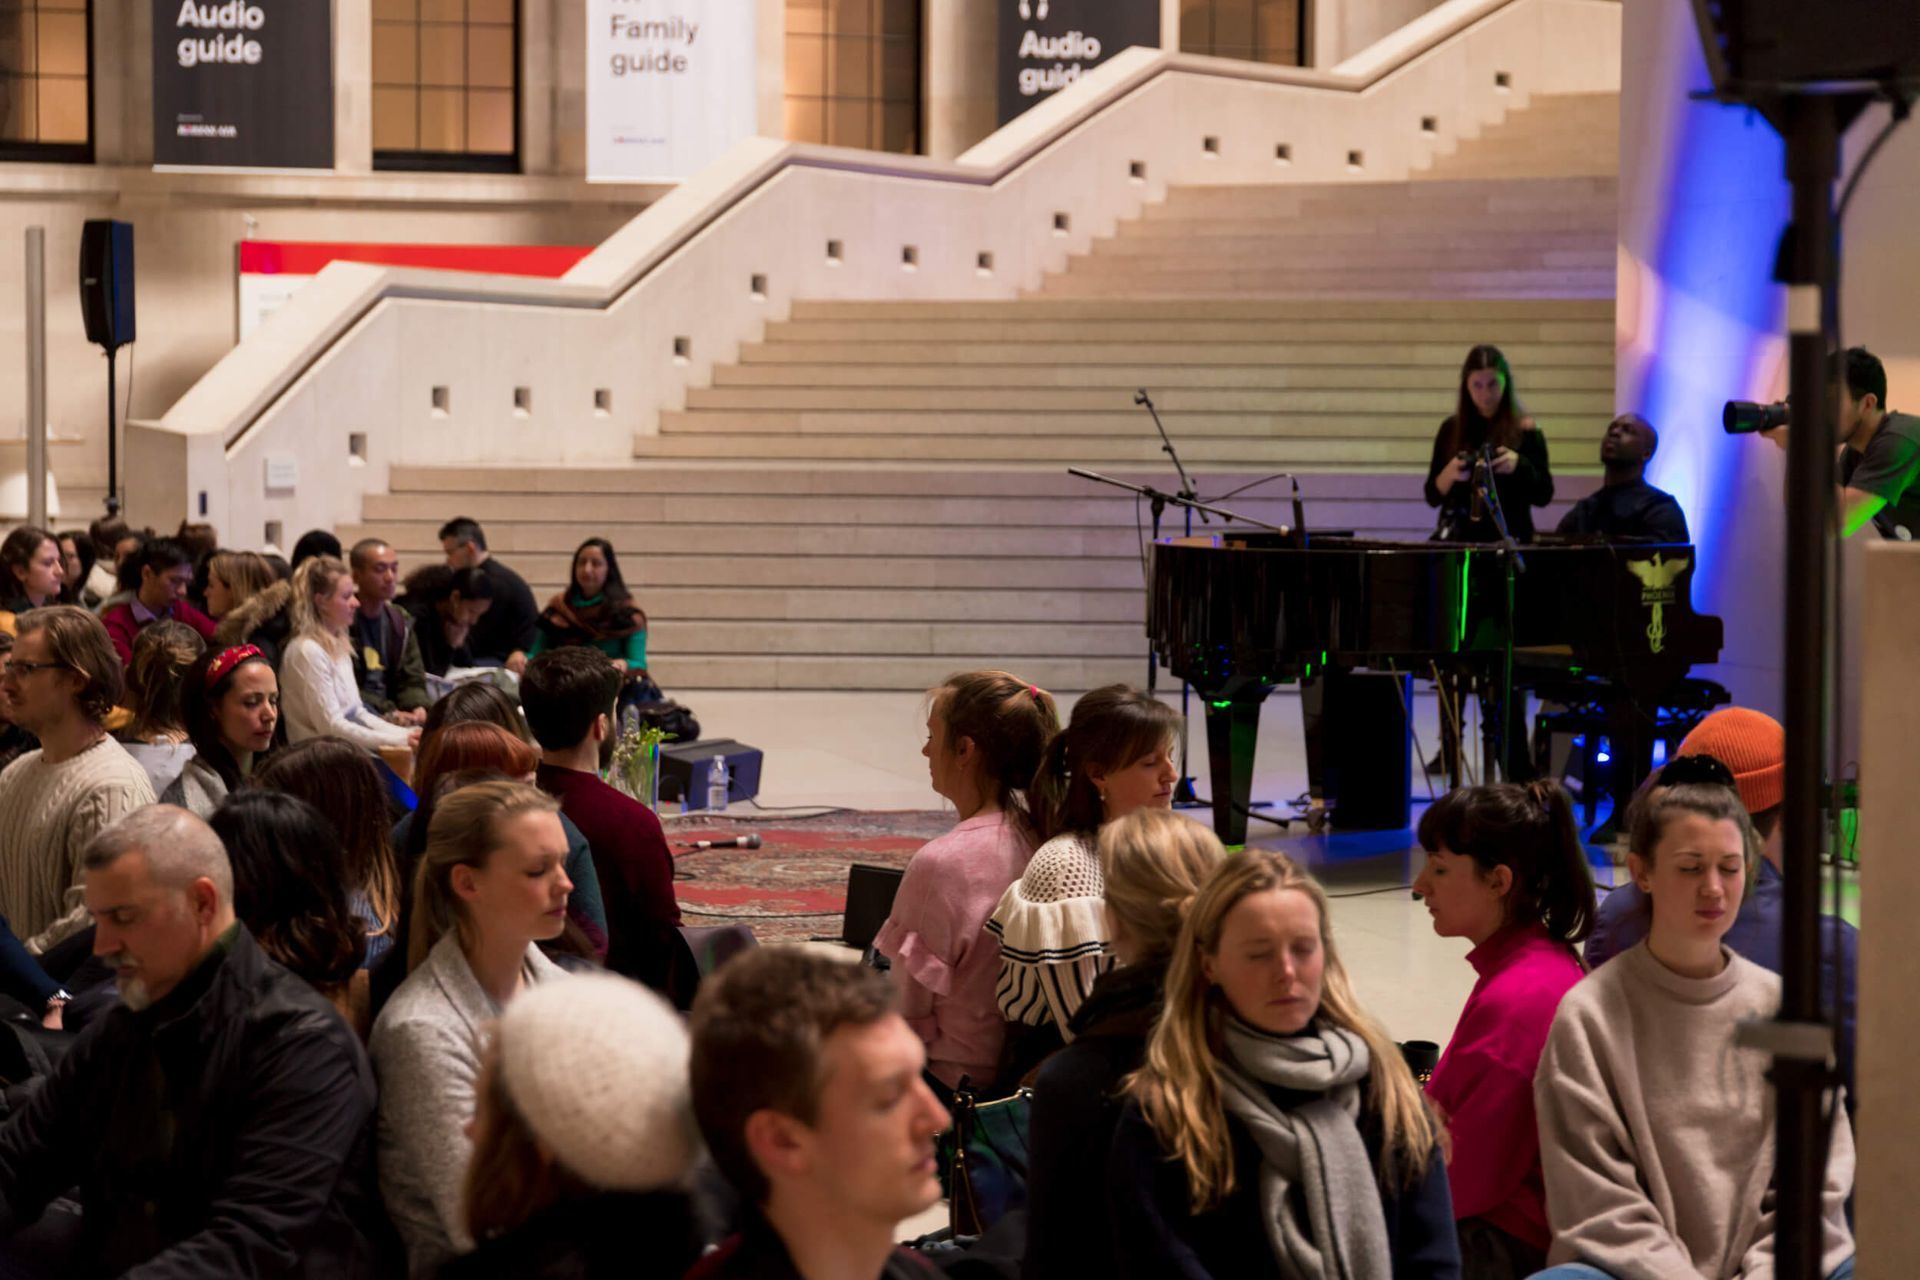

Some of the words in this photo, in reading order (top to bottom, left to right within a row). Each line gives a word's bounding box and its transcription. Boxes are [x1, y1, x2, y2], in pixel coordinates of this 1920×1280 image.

[177, 0, 265, 29] Audio
[610, 14, 699, 45] Family
[177, 33, 262, 67] guide
[1018, 30, 1101, 59] Audio
[610, 50, 688, 76] guide
[1018, 63, 1093, 95] guid
